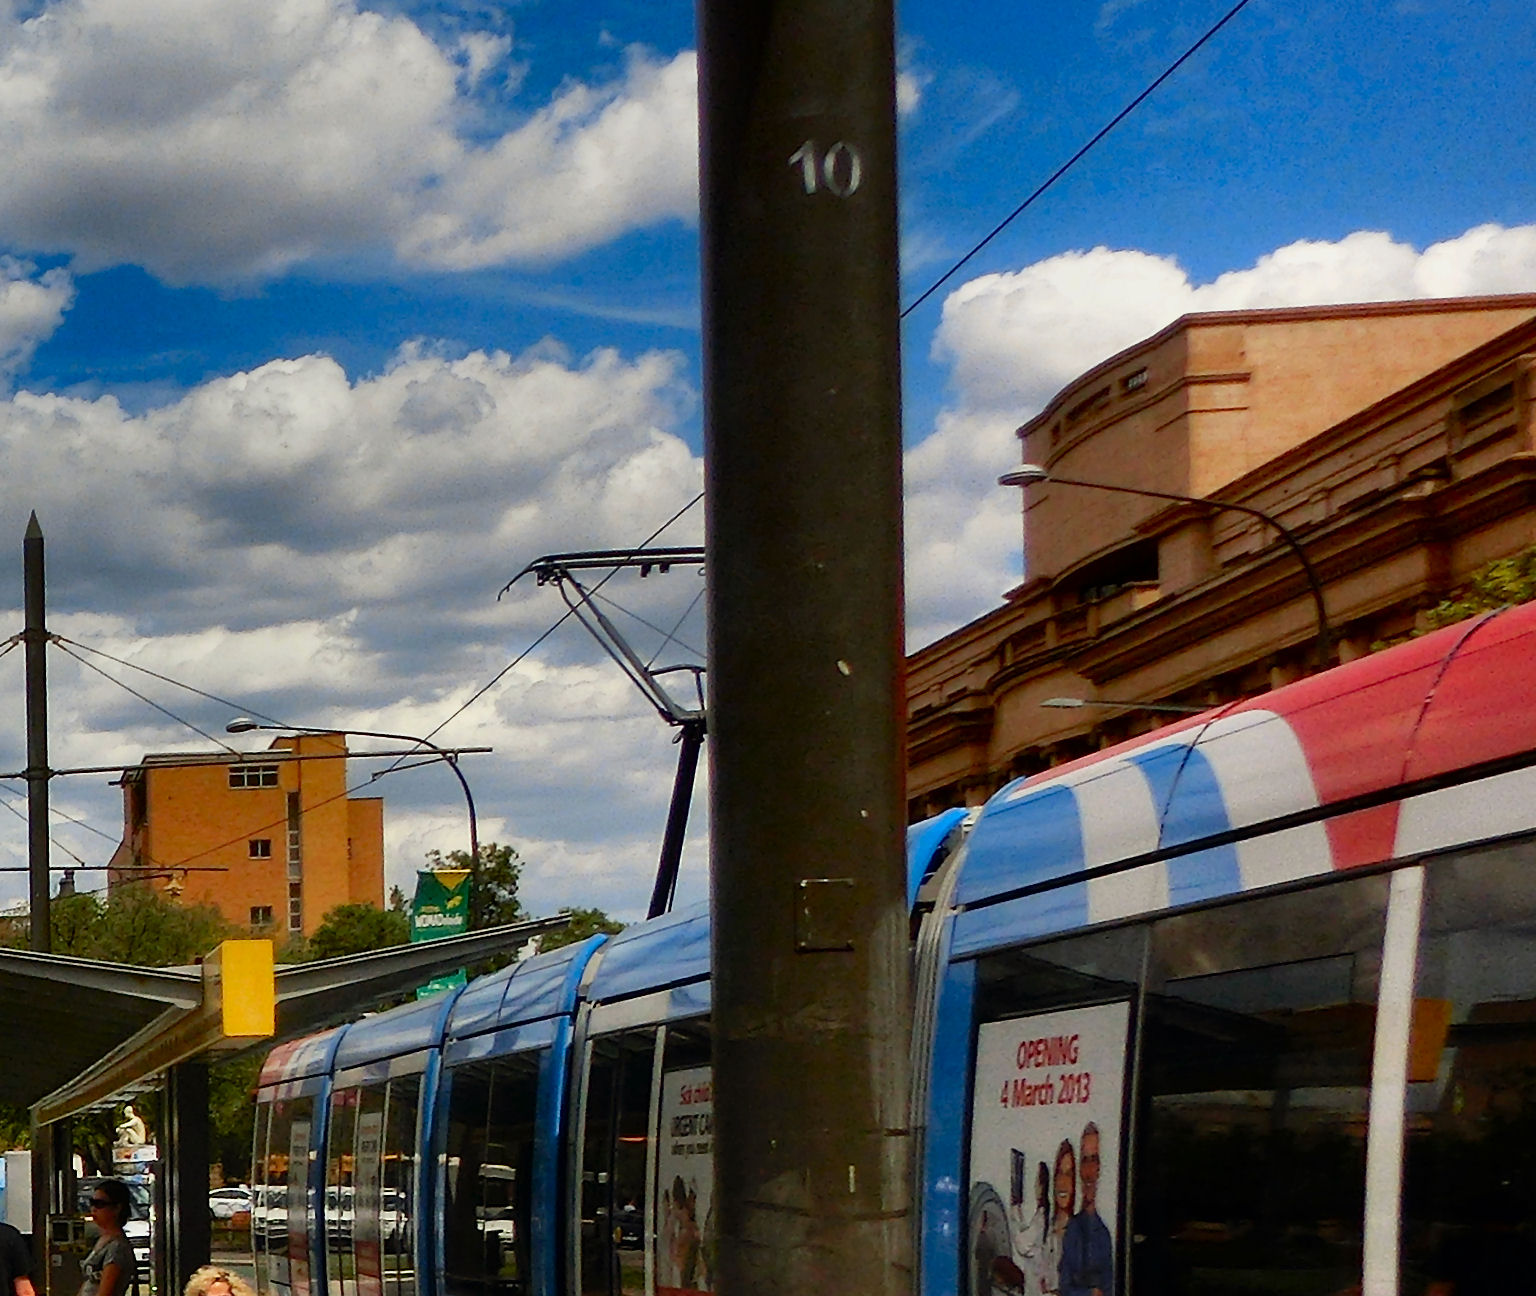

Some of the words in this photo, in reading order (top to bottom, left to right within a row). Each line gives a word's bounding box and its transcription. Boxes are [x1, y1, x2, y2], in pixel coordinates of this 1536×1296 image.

[787, 139, 862, 198] 10
[1016, 1034, 1079, 1069] OPENING
[1000, 1080, 1009, 1108] 4
[1011, 1074, 1054, 1108] March
[1057, 1072, 1090, 1104] 2013
